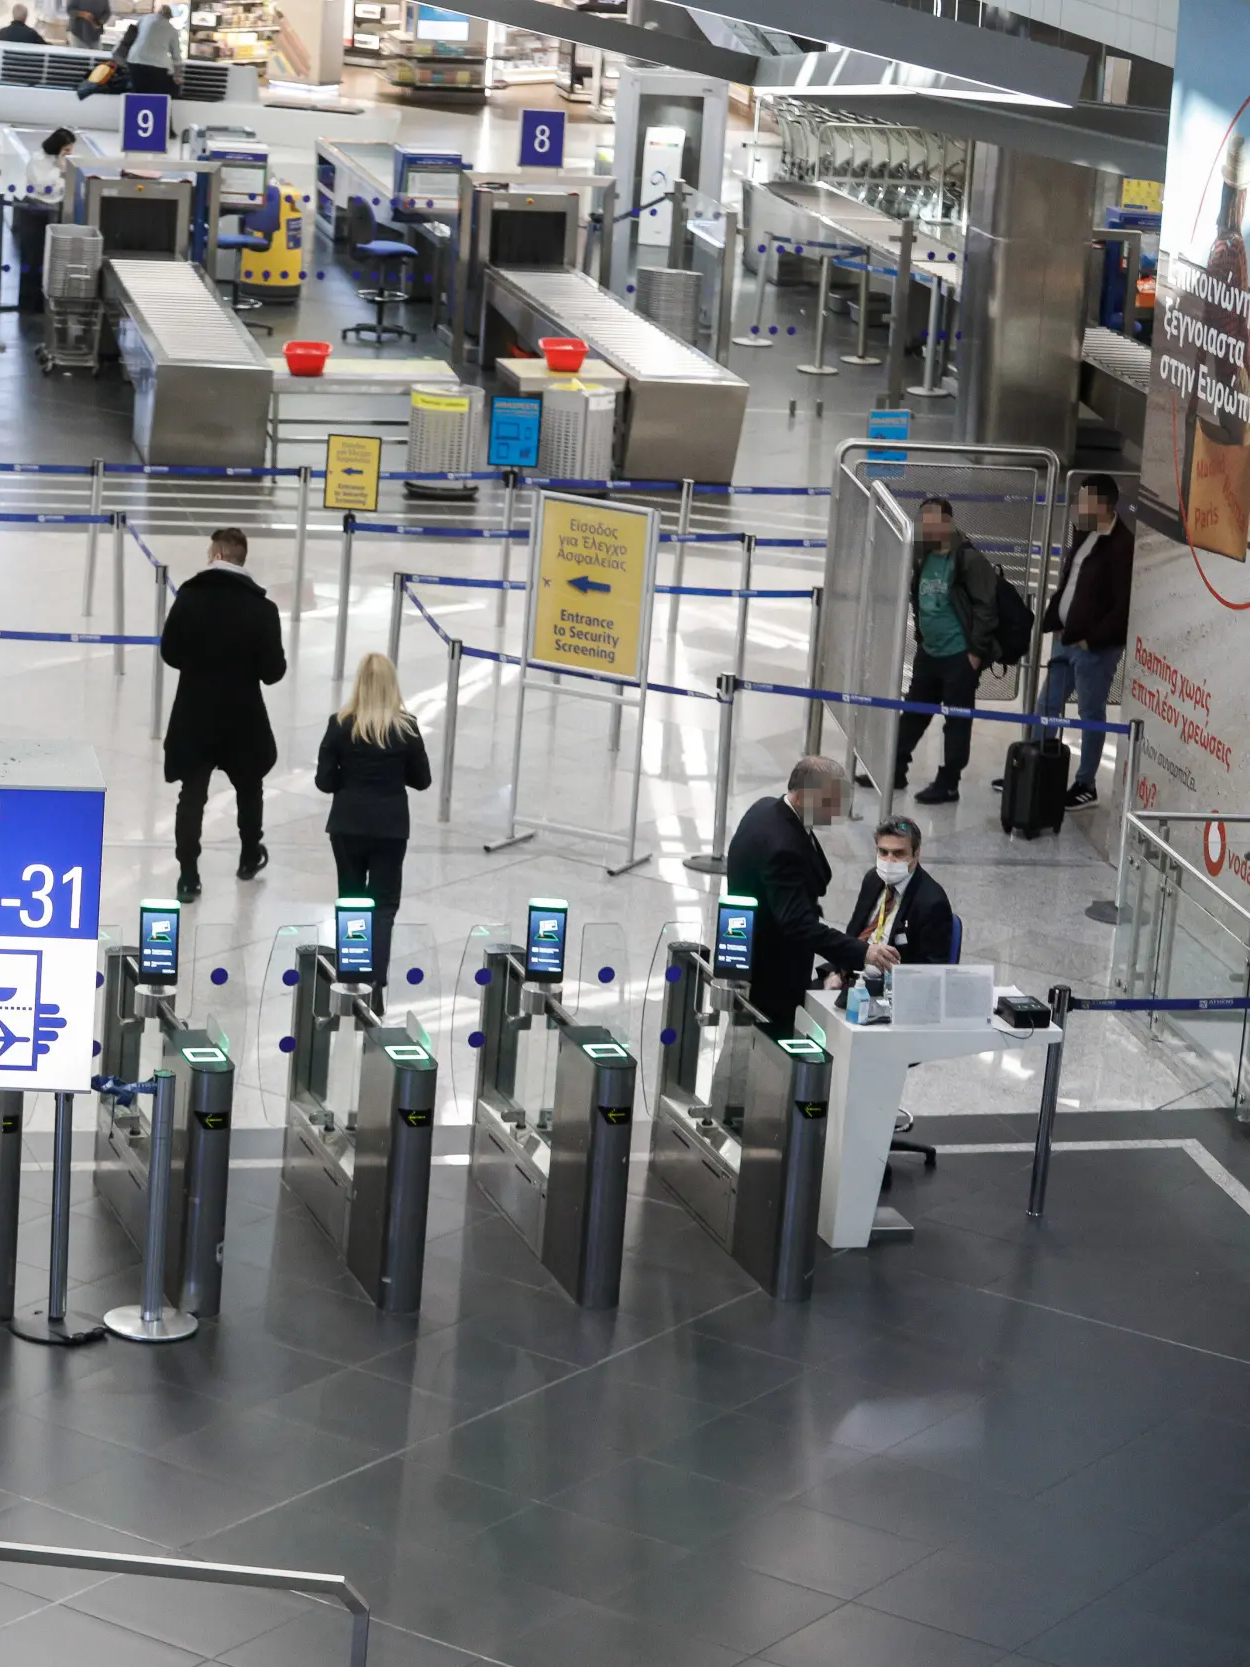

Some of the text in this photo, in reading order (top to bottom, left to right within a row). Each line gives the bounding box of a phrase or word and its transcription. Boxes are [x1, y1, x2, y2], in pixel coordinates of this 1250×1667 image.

[137, 109, 154, 138] 9
[533, 124, 550, 153] 8
[1163, 296, 1246, 368] ξέγνοιαστα
[1159, 354, 1196, 399] στην
[569, 518, 619, 540] Είσοδος
[558, 535, 628, 557] για Έλεγχο
[557, 549, 627, 572] Ασφαλείας
[561, 609, 614, 629] Entrance
[553, 624, 620, 649] to Security
[555, 639, 616, 663] Screening
[1135, 636, 1211, 717] Roaming χωρίς
[1131, 679, 1232, 773] επιπλέον χρεώσεις
